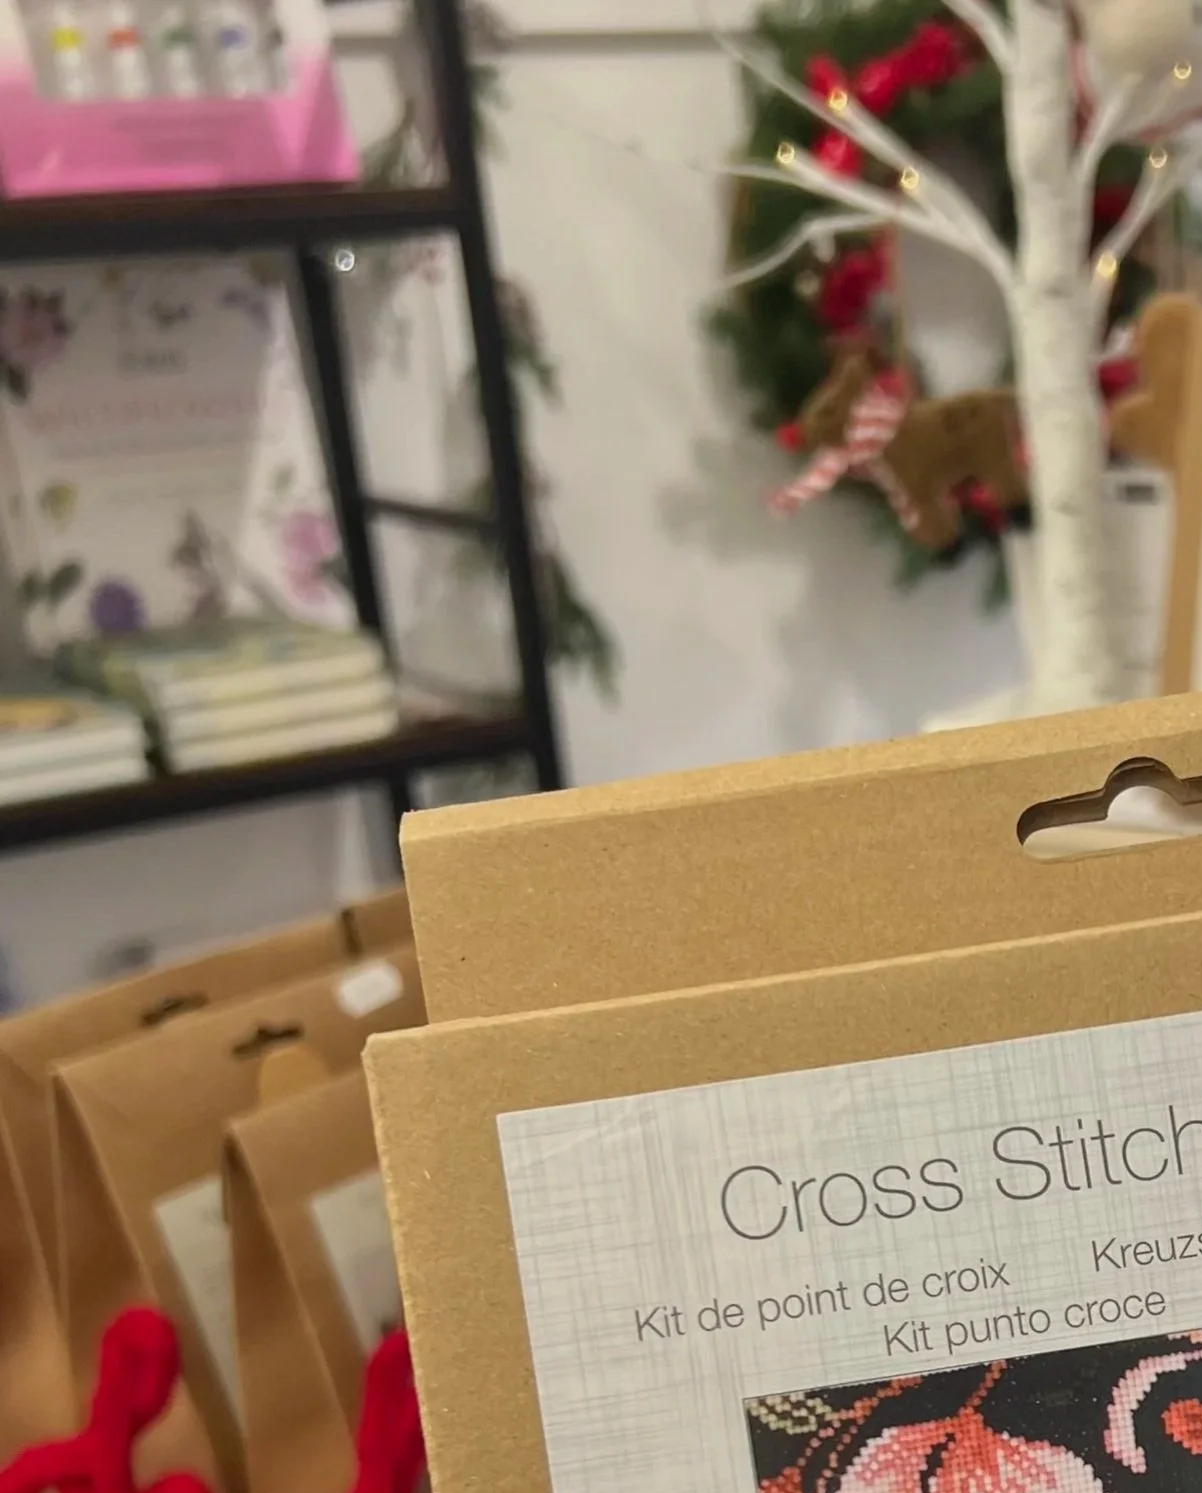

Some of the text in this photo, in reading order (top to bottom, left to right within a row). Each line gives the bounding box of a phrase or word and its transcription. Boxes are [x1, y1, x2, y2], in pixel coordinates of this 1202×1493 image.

[721, 1158, 963, 1240] Cross
[635, 1258, 1010, 1341] Kit de point de croix
[884, 1291, 1166, 1356] Kit punto croce
